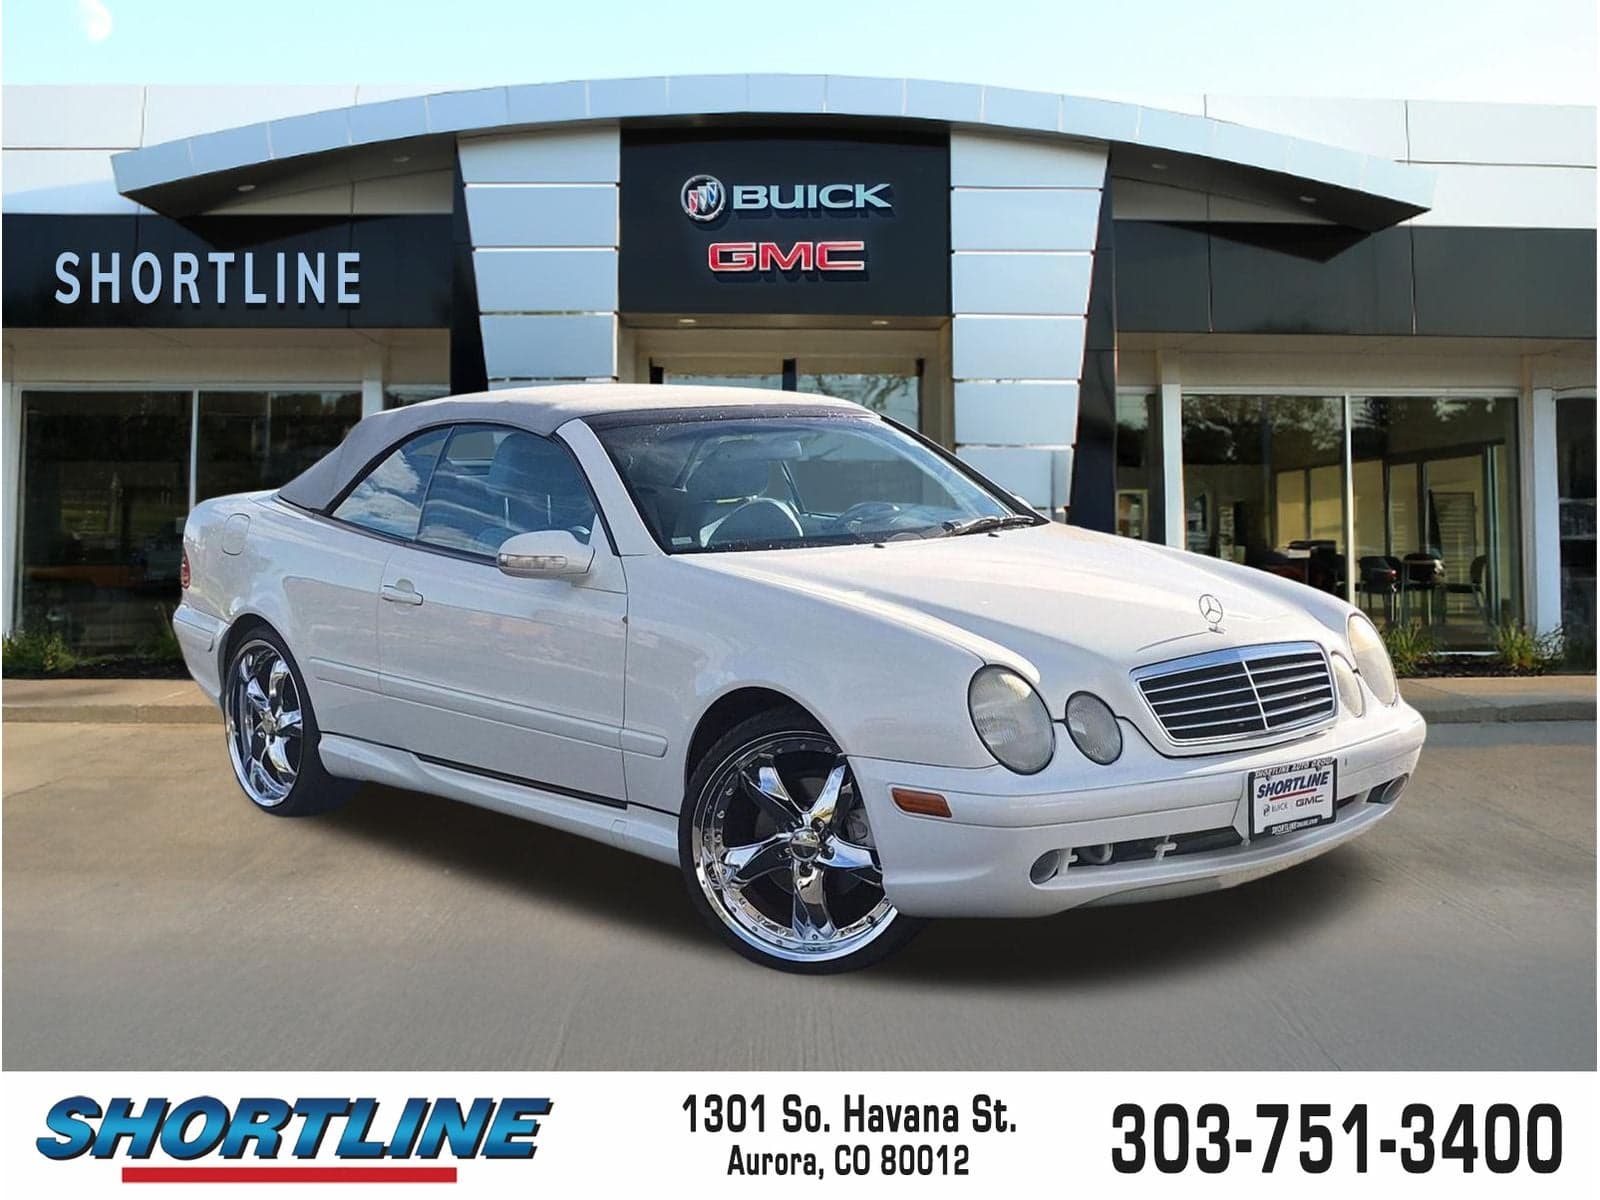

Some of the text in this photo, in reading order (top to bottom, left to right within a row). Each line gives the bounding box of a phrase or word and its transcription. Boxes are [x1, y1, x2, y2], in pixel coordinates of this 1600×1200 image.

[732, 184, 892, 210] BUICK
[708, 241, 865, 271] GMC
[54, 251, 361, 304] SHORTLINE
[1257, 771, 1330, 798] SHORTLINE
[1295, 794, 1324, 807] GMC
